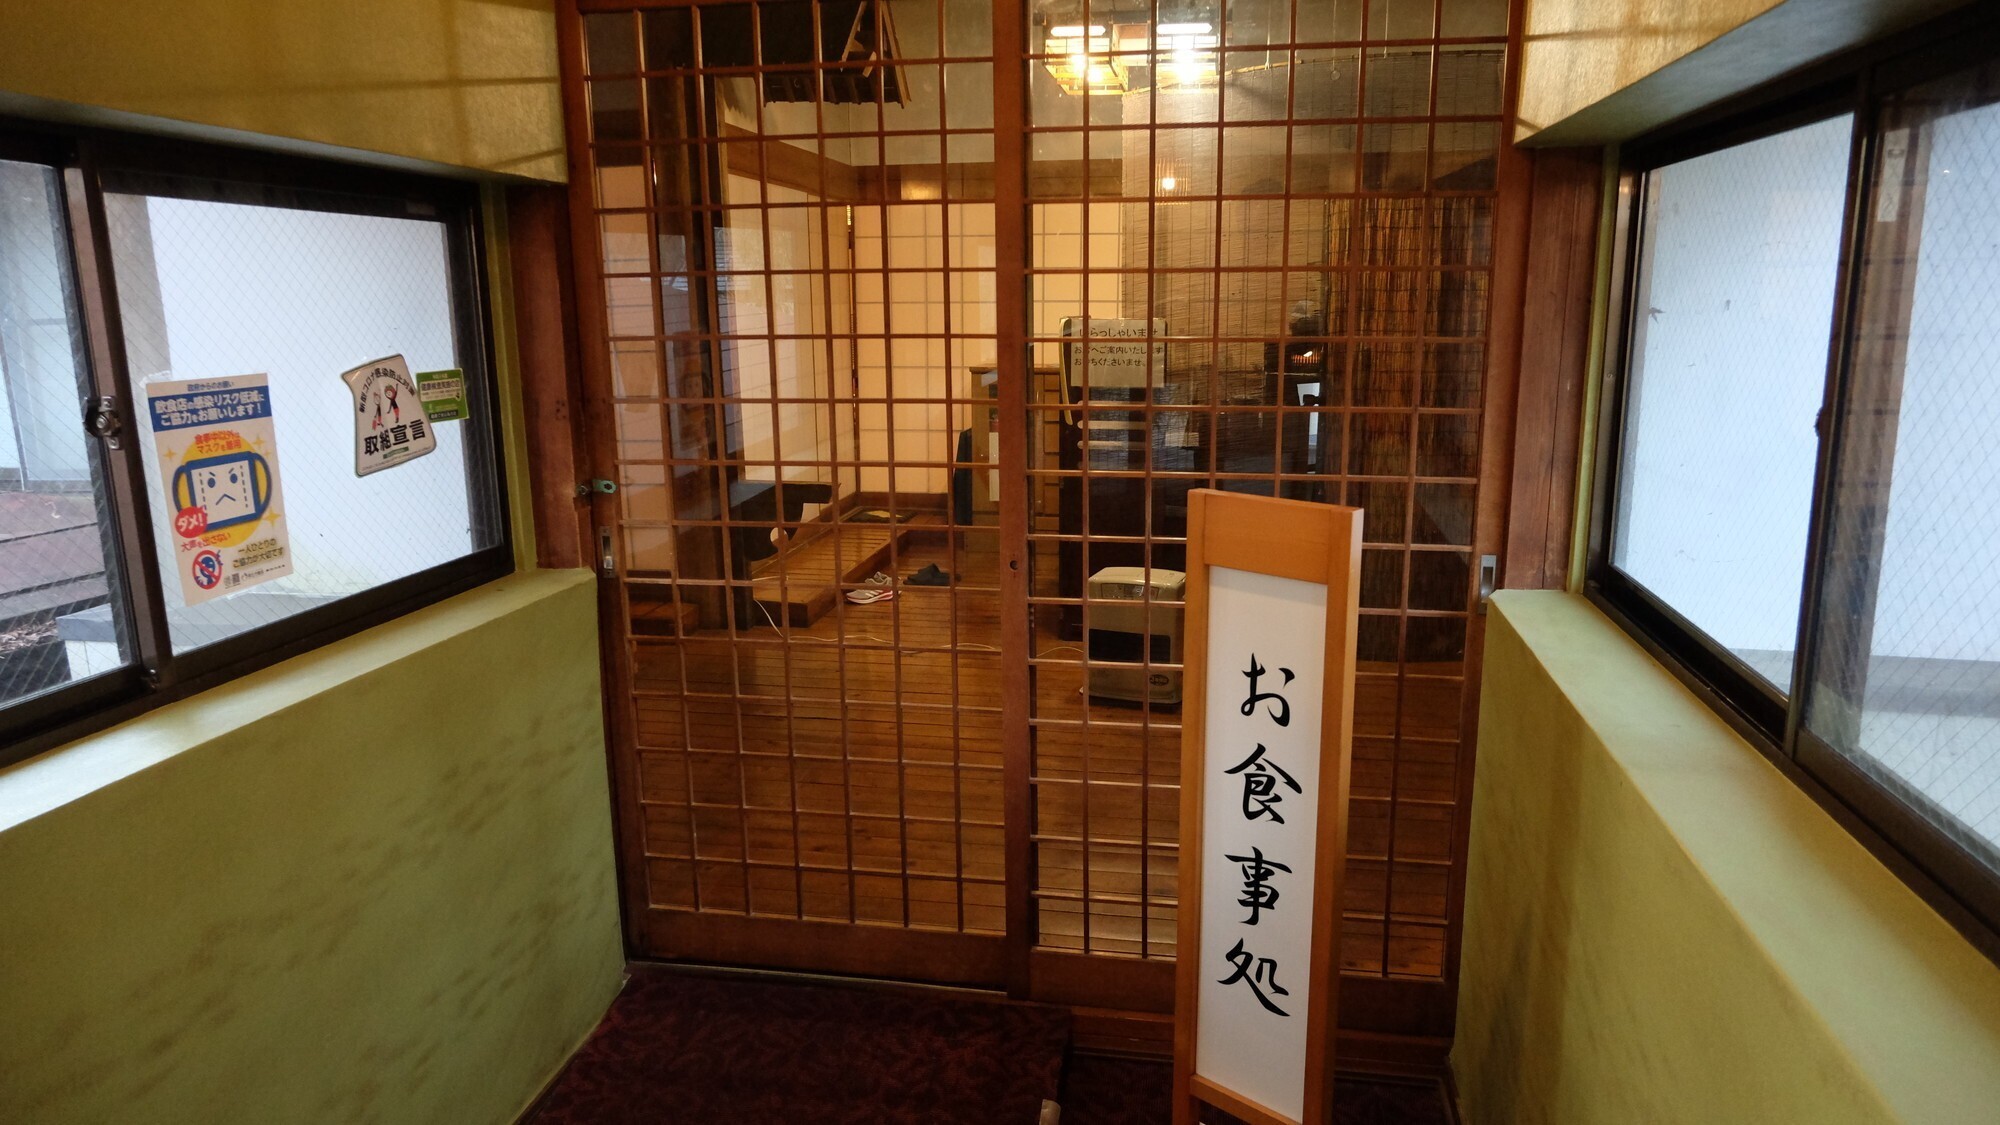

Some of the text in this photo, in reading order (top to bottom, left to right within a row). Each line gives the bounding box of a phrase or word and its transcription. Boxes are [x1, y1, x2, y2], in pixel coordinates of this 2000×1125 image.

[1073, 345, 1164, 354] おへご案内いたしす
[1073, 358, 1147, 367] おちくださいませ。
[154, 390, 265, 414] 飲食店の感染リスク低減に
[359, 368, 416, 413] 新型コロナ感染防止対策
[363, 418, 426, 456] 取組宣言
[180, 532, 231, 553] 大声を出さない
[1217, 652, 1303, 1017] お食事処
